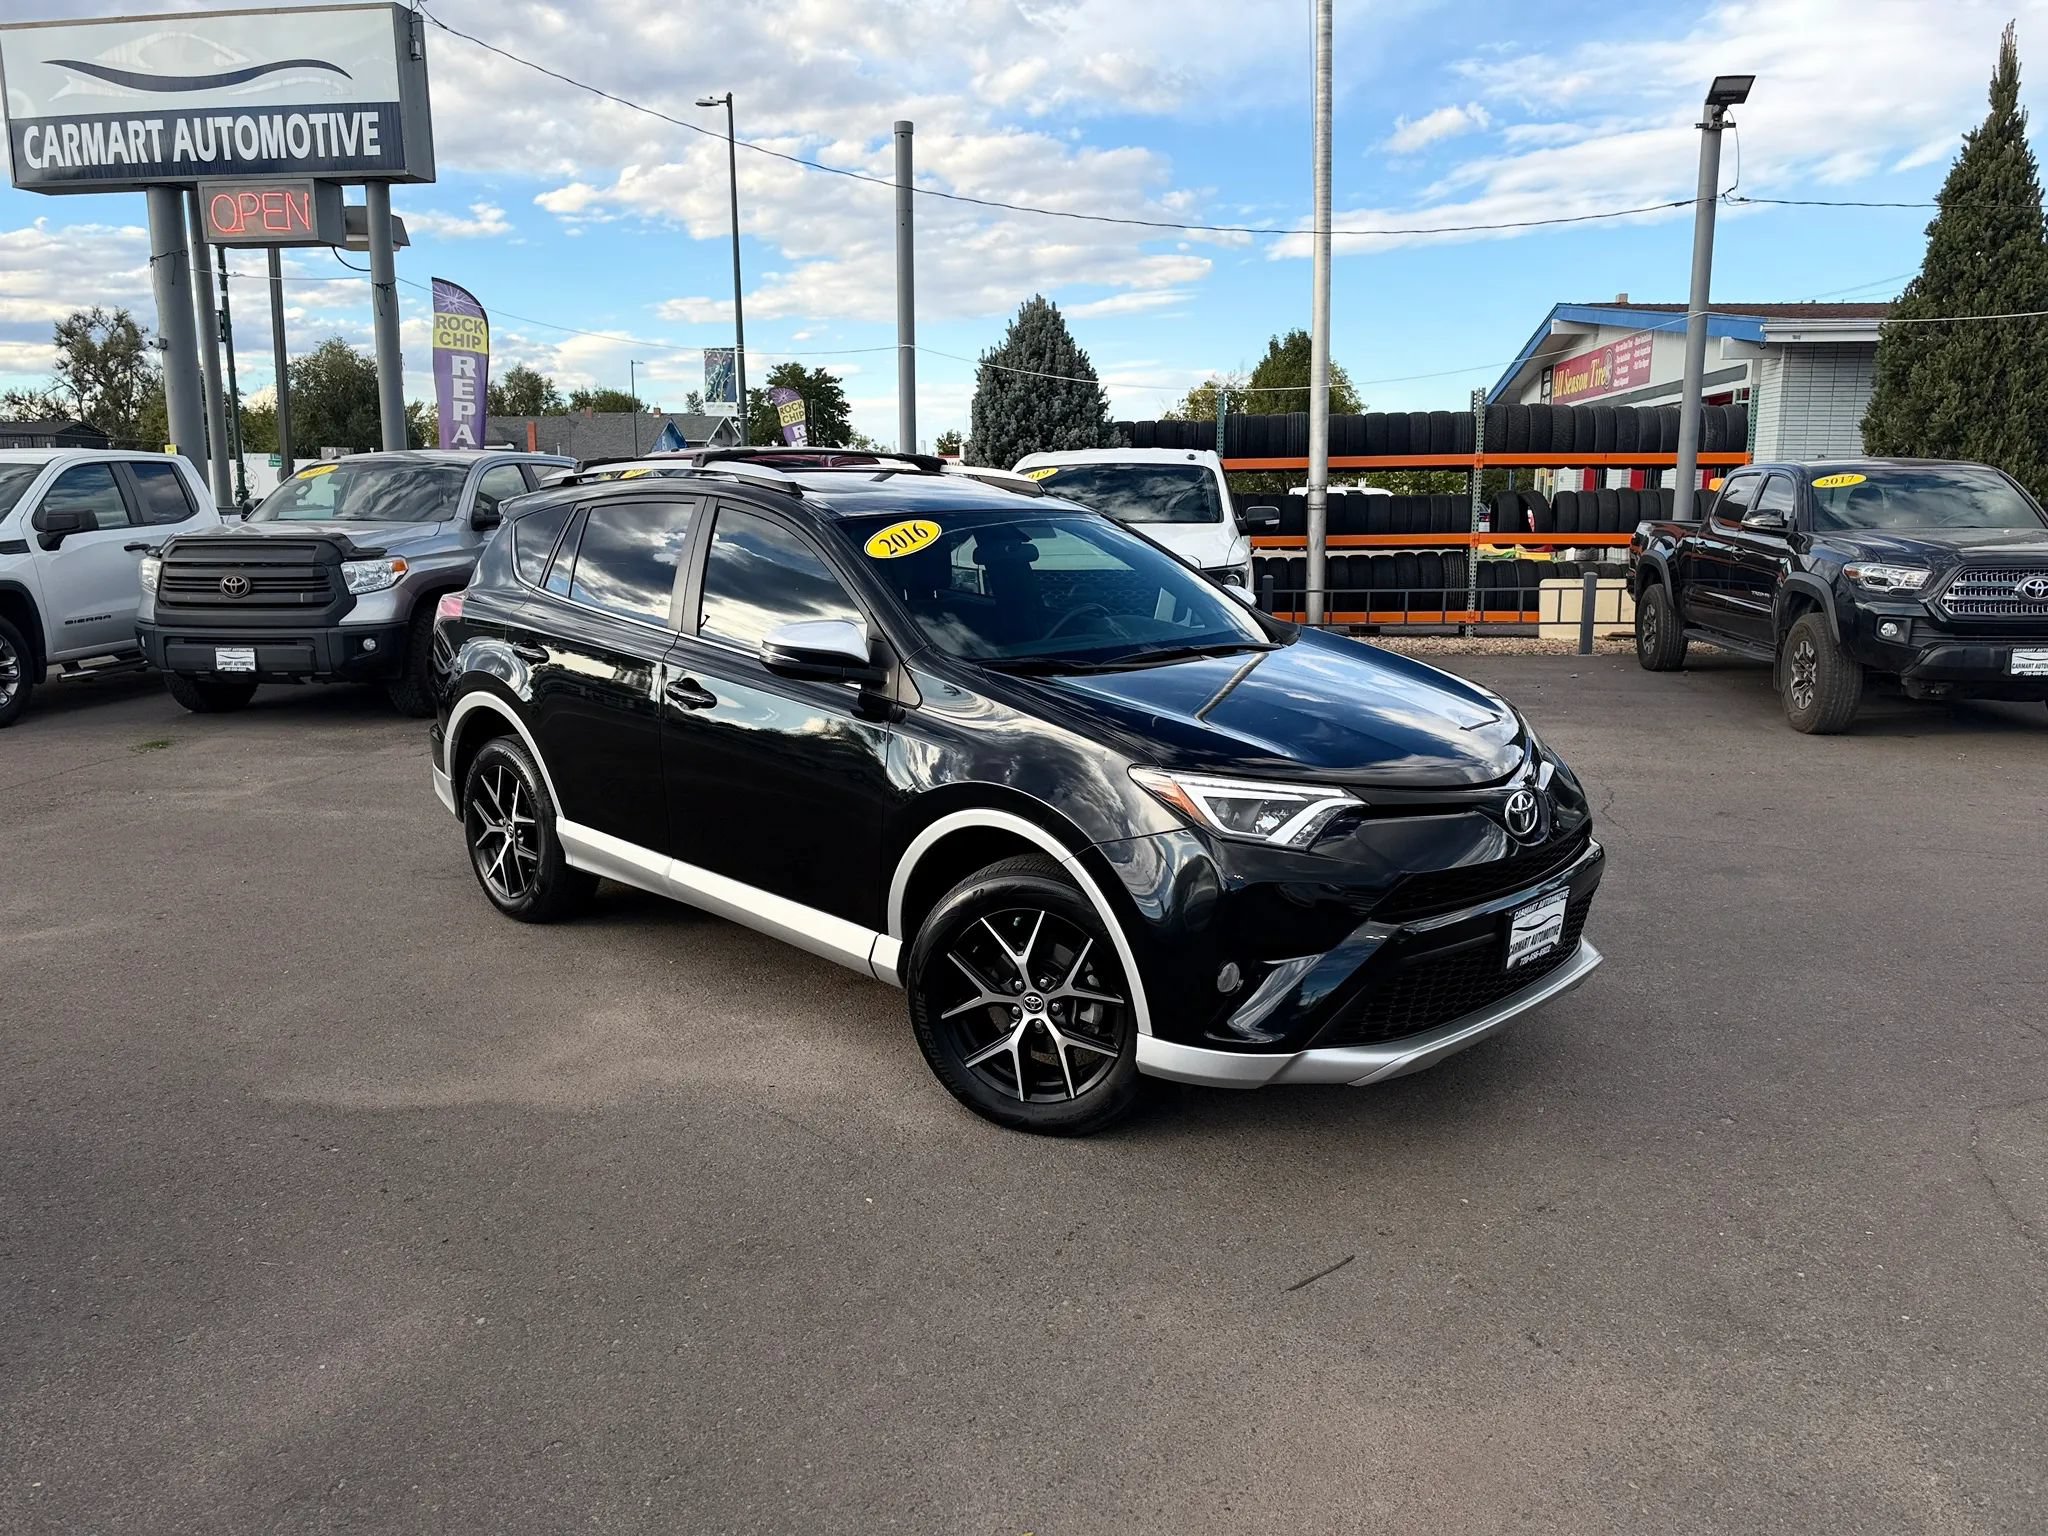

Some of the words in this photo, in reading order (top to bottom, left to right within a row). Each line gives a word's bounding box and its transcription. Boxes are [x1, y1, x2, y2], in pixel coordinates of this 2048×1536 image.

[24, 119, 164, 169] CARMART
[173, 112, 381, 163] AUTOMOTIVE
[211, 192, 311, 233] OPEN
[435, 315, 484, 335] ROCK
[439, 332, 482, 349] CHIP
[1553, 369, 1565, 397] All
[1564, 368, 1589, 394] Season
[451, 355, 477, 450] REPA
[780, 401, 805, 415] ROCK
[782, 411, 805, 424] CHIP
[1822, 475, 1855, 486] 2017
[879, 522, 929, 555] 2016
[64, 614, 112, 625] SIERRA
[1514, 902, 1539, 920] CARMART
[1509, 935, 1532, 956] CARMART
[1530, 922, 1561, 947] AUTOMOTIVE
